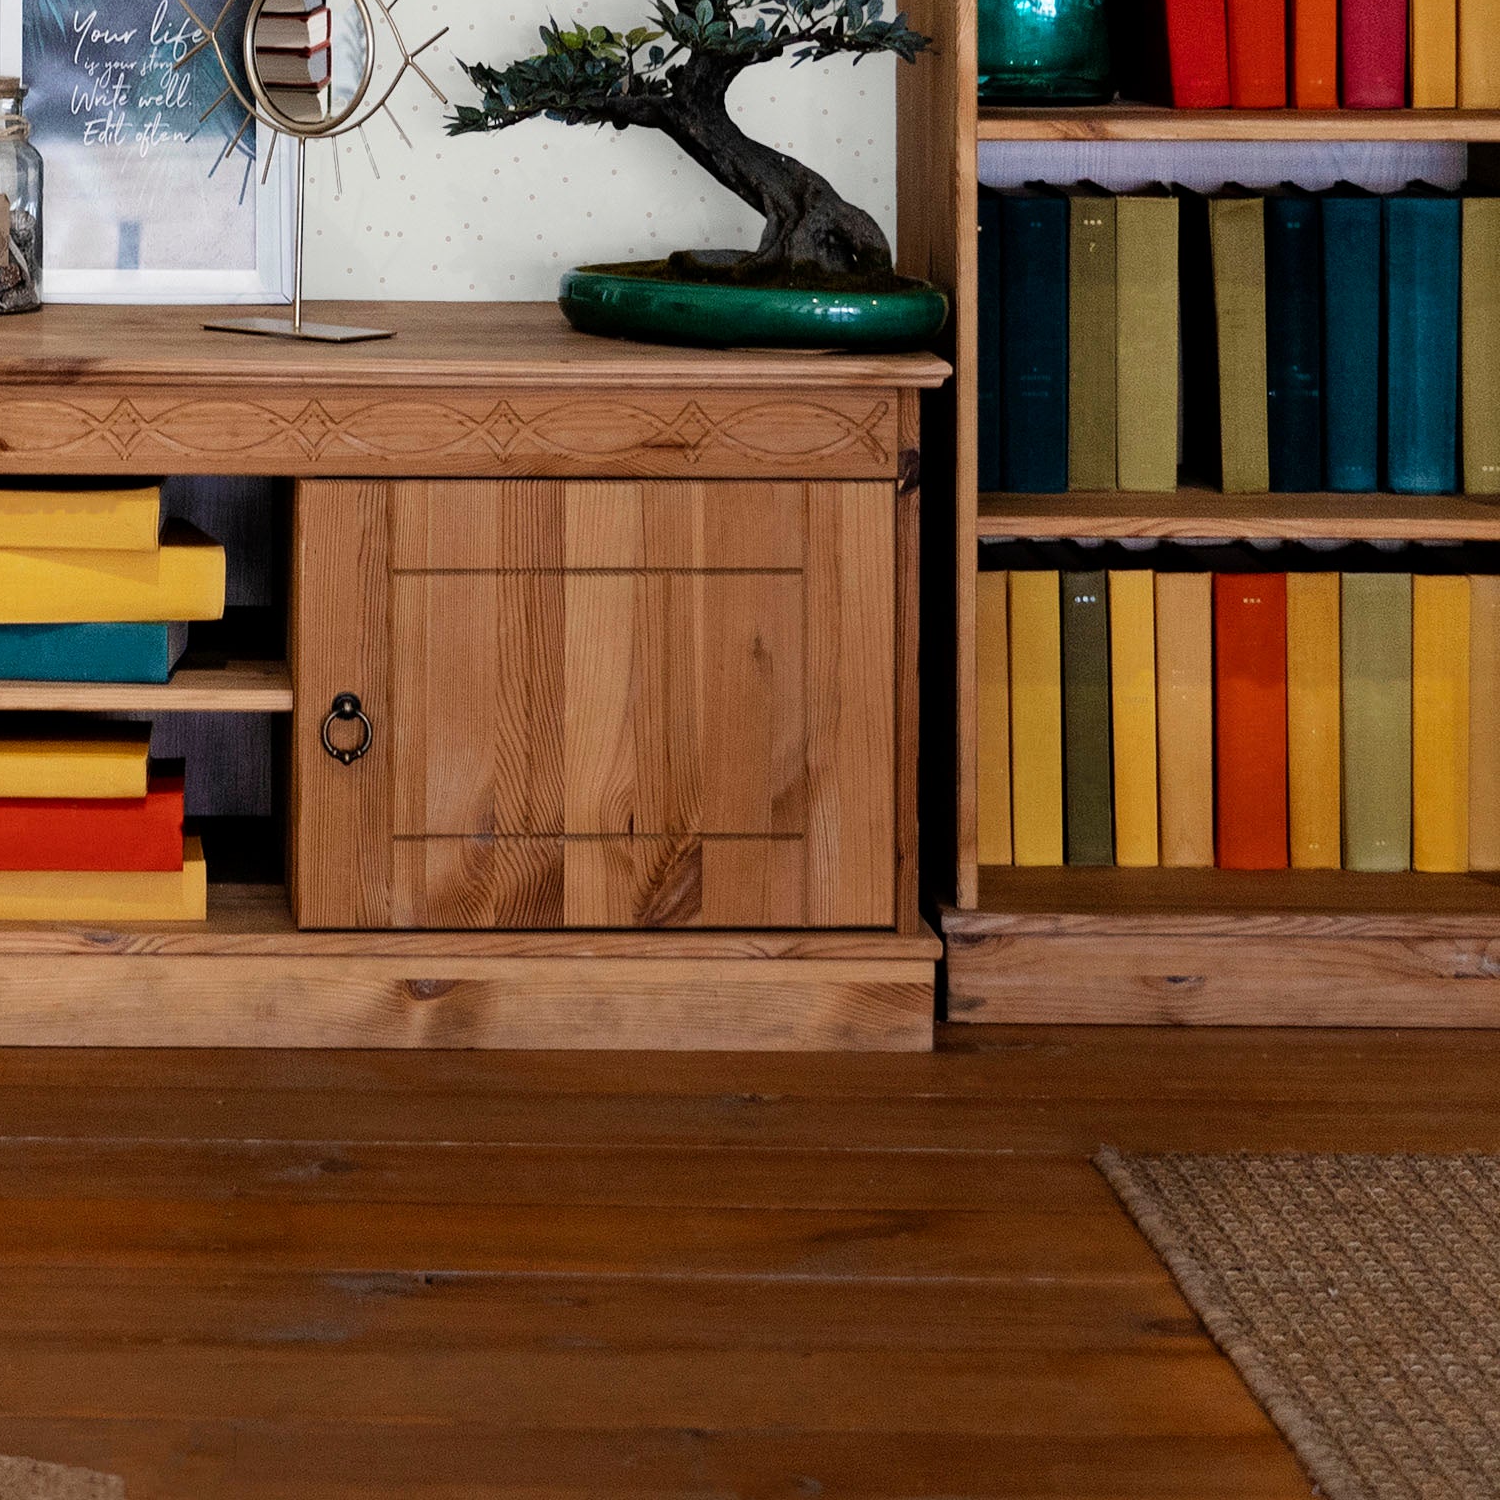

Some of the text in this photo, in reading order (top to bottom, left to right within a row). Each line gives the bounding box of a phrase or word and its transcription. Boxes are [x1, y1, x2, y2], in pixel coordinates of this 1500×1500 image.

[73, 10, 137, 63] Your
[71, 72, 192, 115] Write well.
[84, 57, 99, 76] is
[99, 59, 137, 89] your
[83, 110, 194, 158] Edit often.
